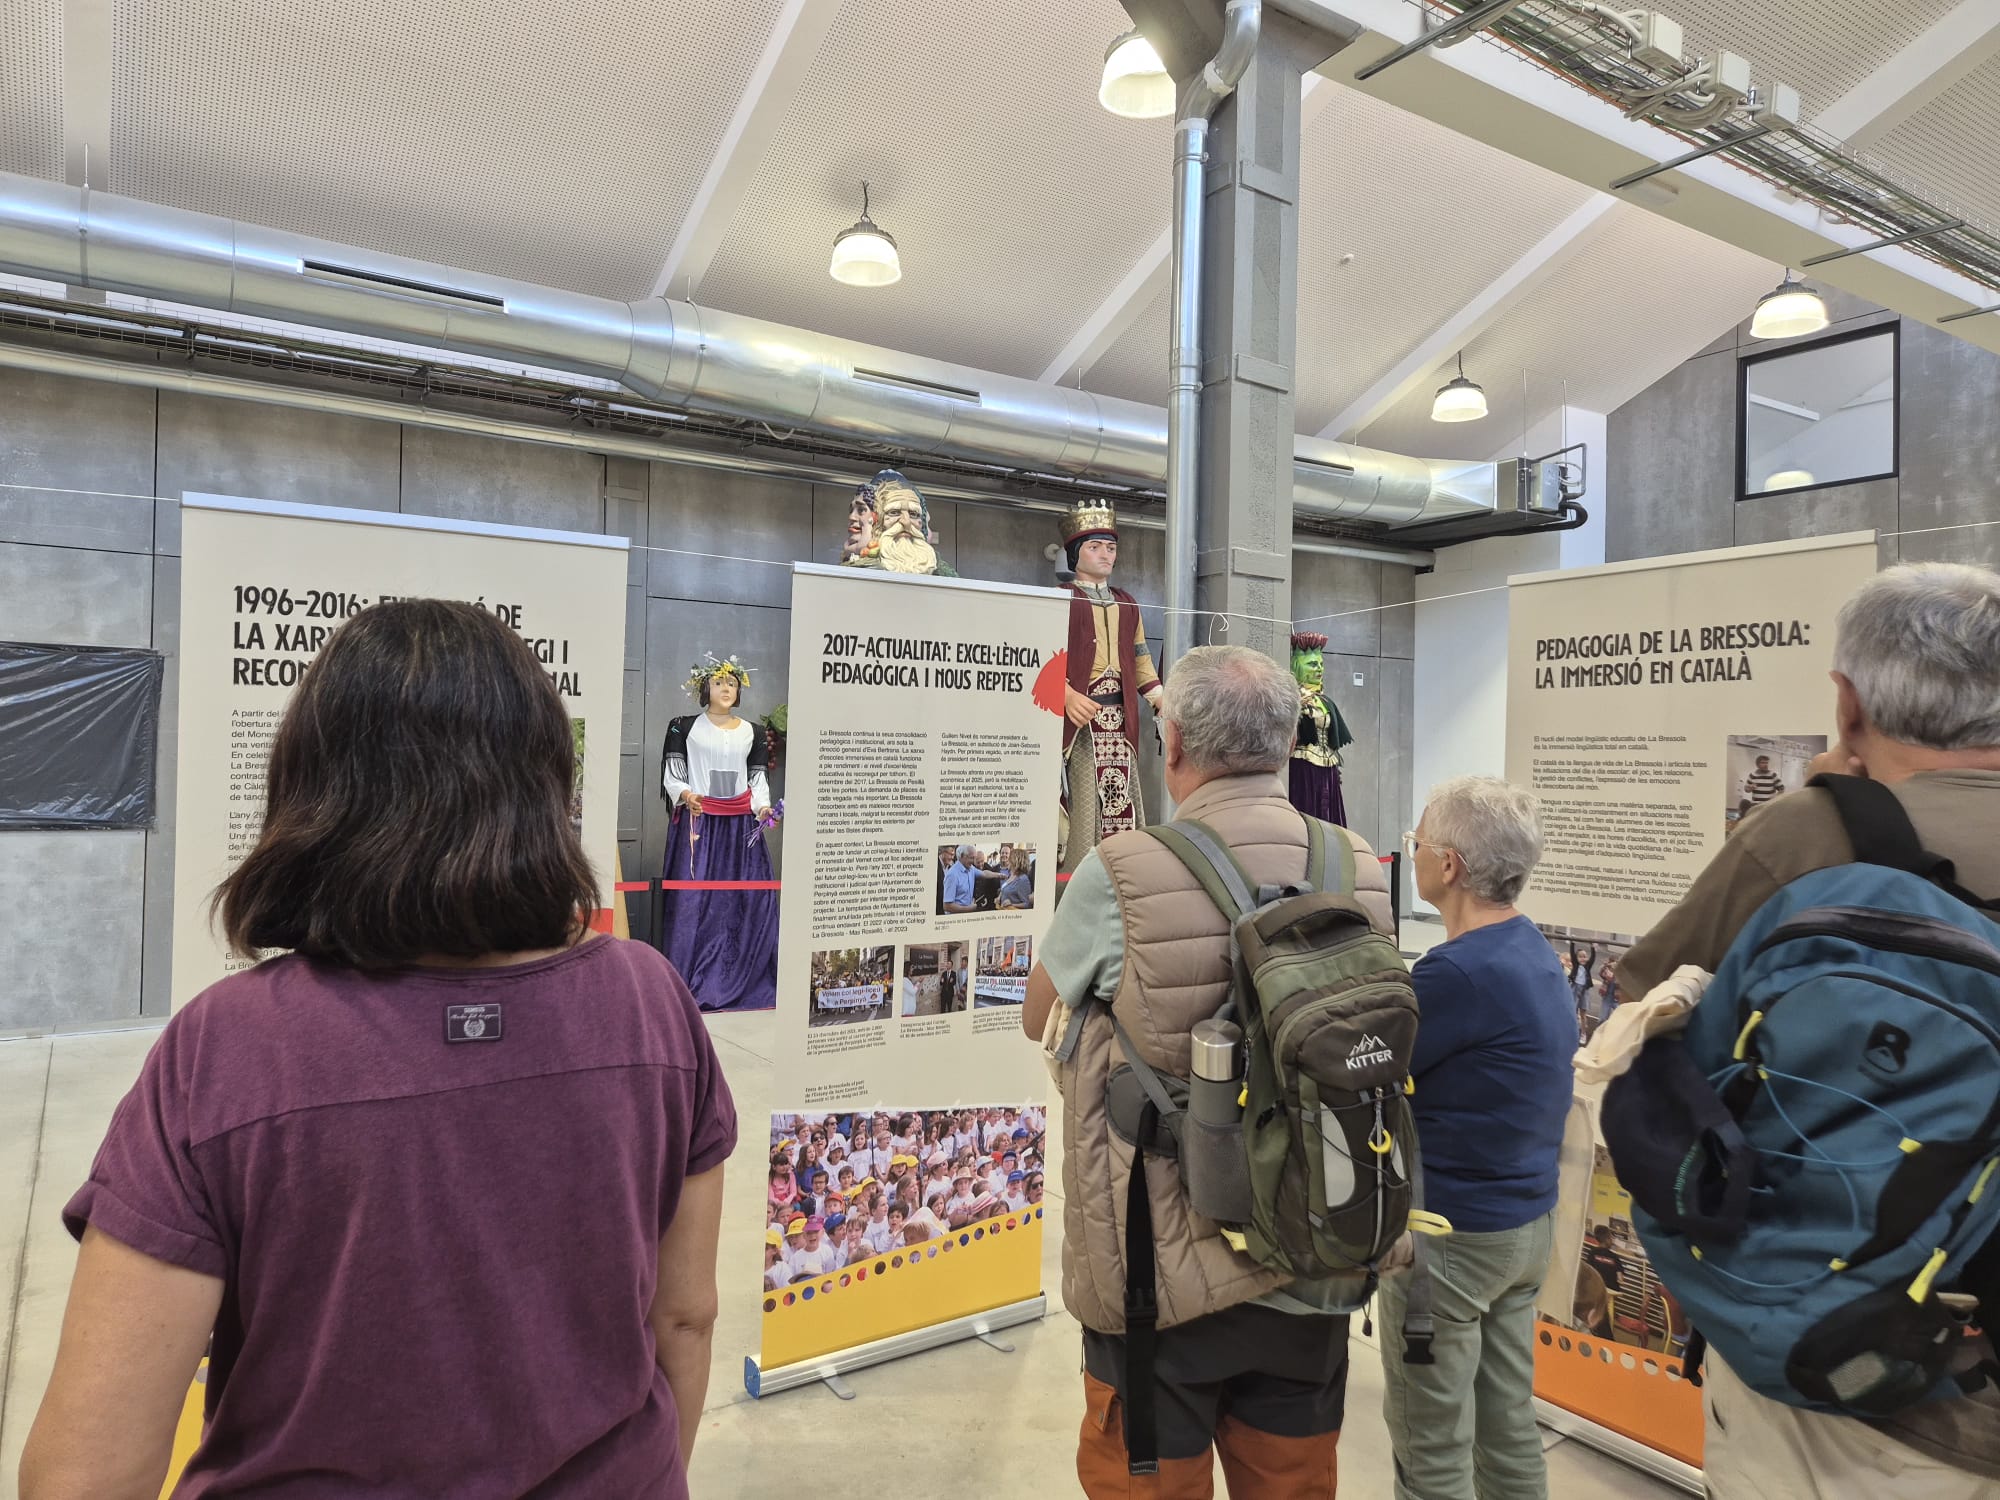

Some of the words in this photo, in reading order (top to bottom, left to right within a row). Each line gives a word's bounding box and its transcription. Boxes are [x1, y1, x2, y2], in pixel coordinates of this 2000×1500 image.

[233, 622, 265, 650] LA
[562, 640, 568, 664] I
[1536, 632, 1632, 661] PEDAGOGIA
[1639, 630, 1663, 655] DE
[1670, 628, 1693, 653] LA
[1700, 620, 1810, 651] BRESSOLA:
[822, 660, 919, 687] PEDAGÒGICA
[924, 667, 929, 688] I
[935, 668, 971, 690] NOUS
[976, 671, 1023, 692] REPTES
[1535, 667, 1554, 689] LA
[1561, 657, 1642, 688] IMMERSIÓ
[1650, 660, 1673, 684] EN
[1680, 651, 1752, 683] CATALÀ
[232, 720, 272, 728] l'obertura
[242, 710, 264, 718] partir
[1345, 1049, 1393, 1070] KITTER
